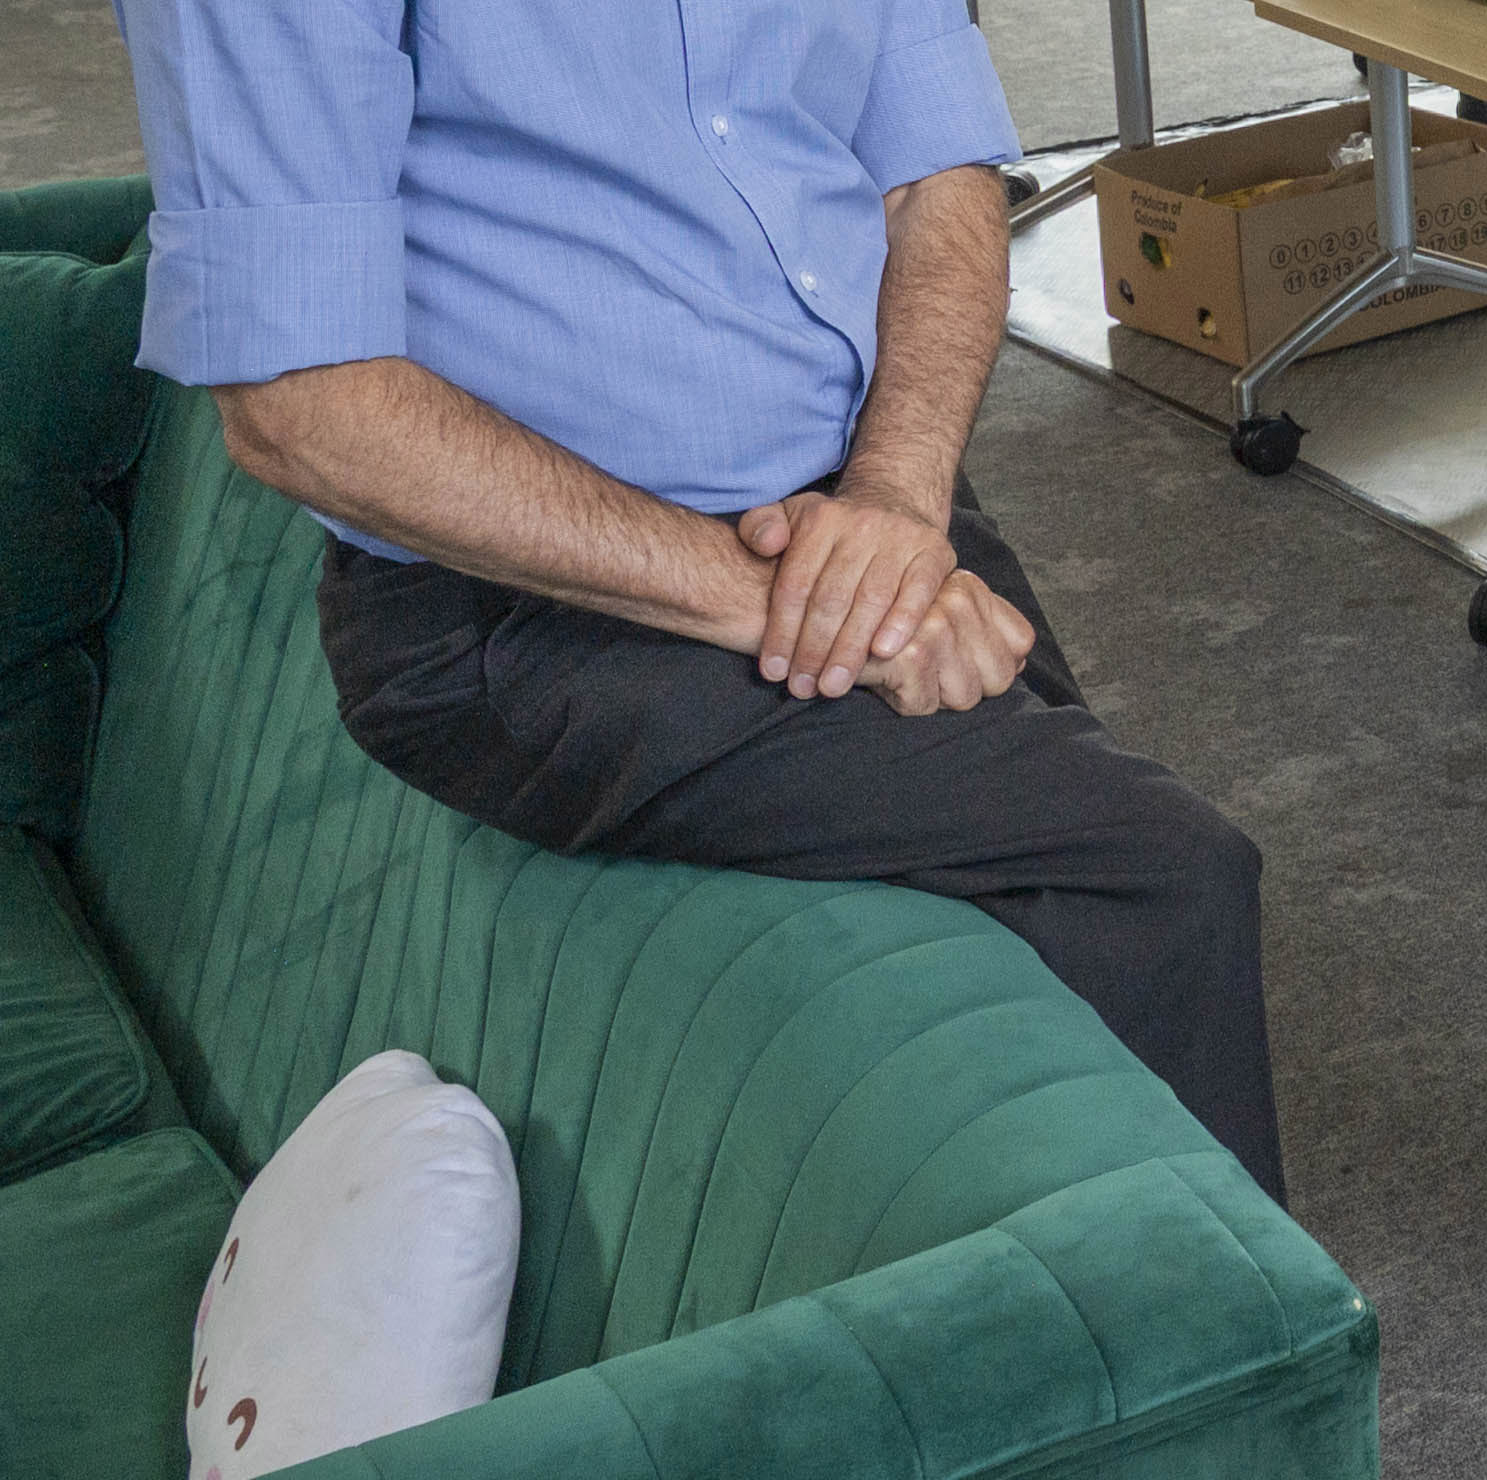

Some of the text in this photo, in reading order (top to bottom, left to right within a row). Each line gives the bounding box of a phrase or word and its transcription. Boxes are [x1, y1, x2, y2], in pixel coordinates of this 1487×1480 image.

[1131, 190, 1183, 216] Produce of
[1134, 208, 1178, 232] Colombia
